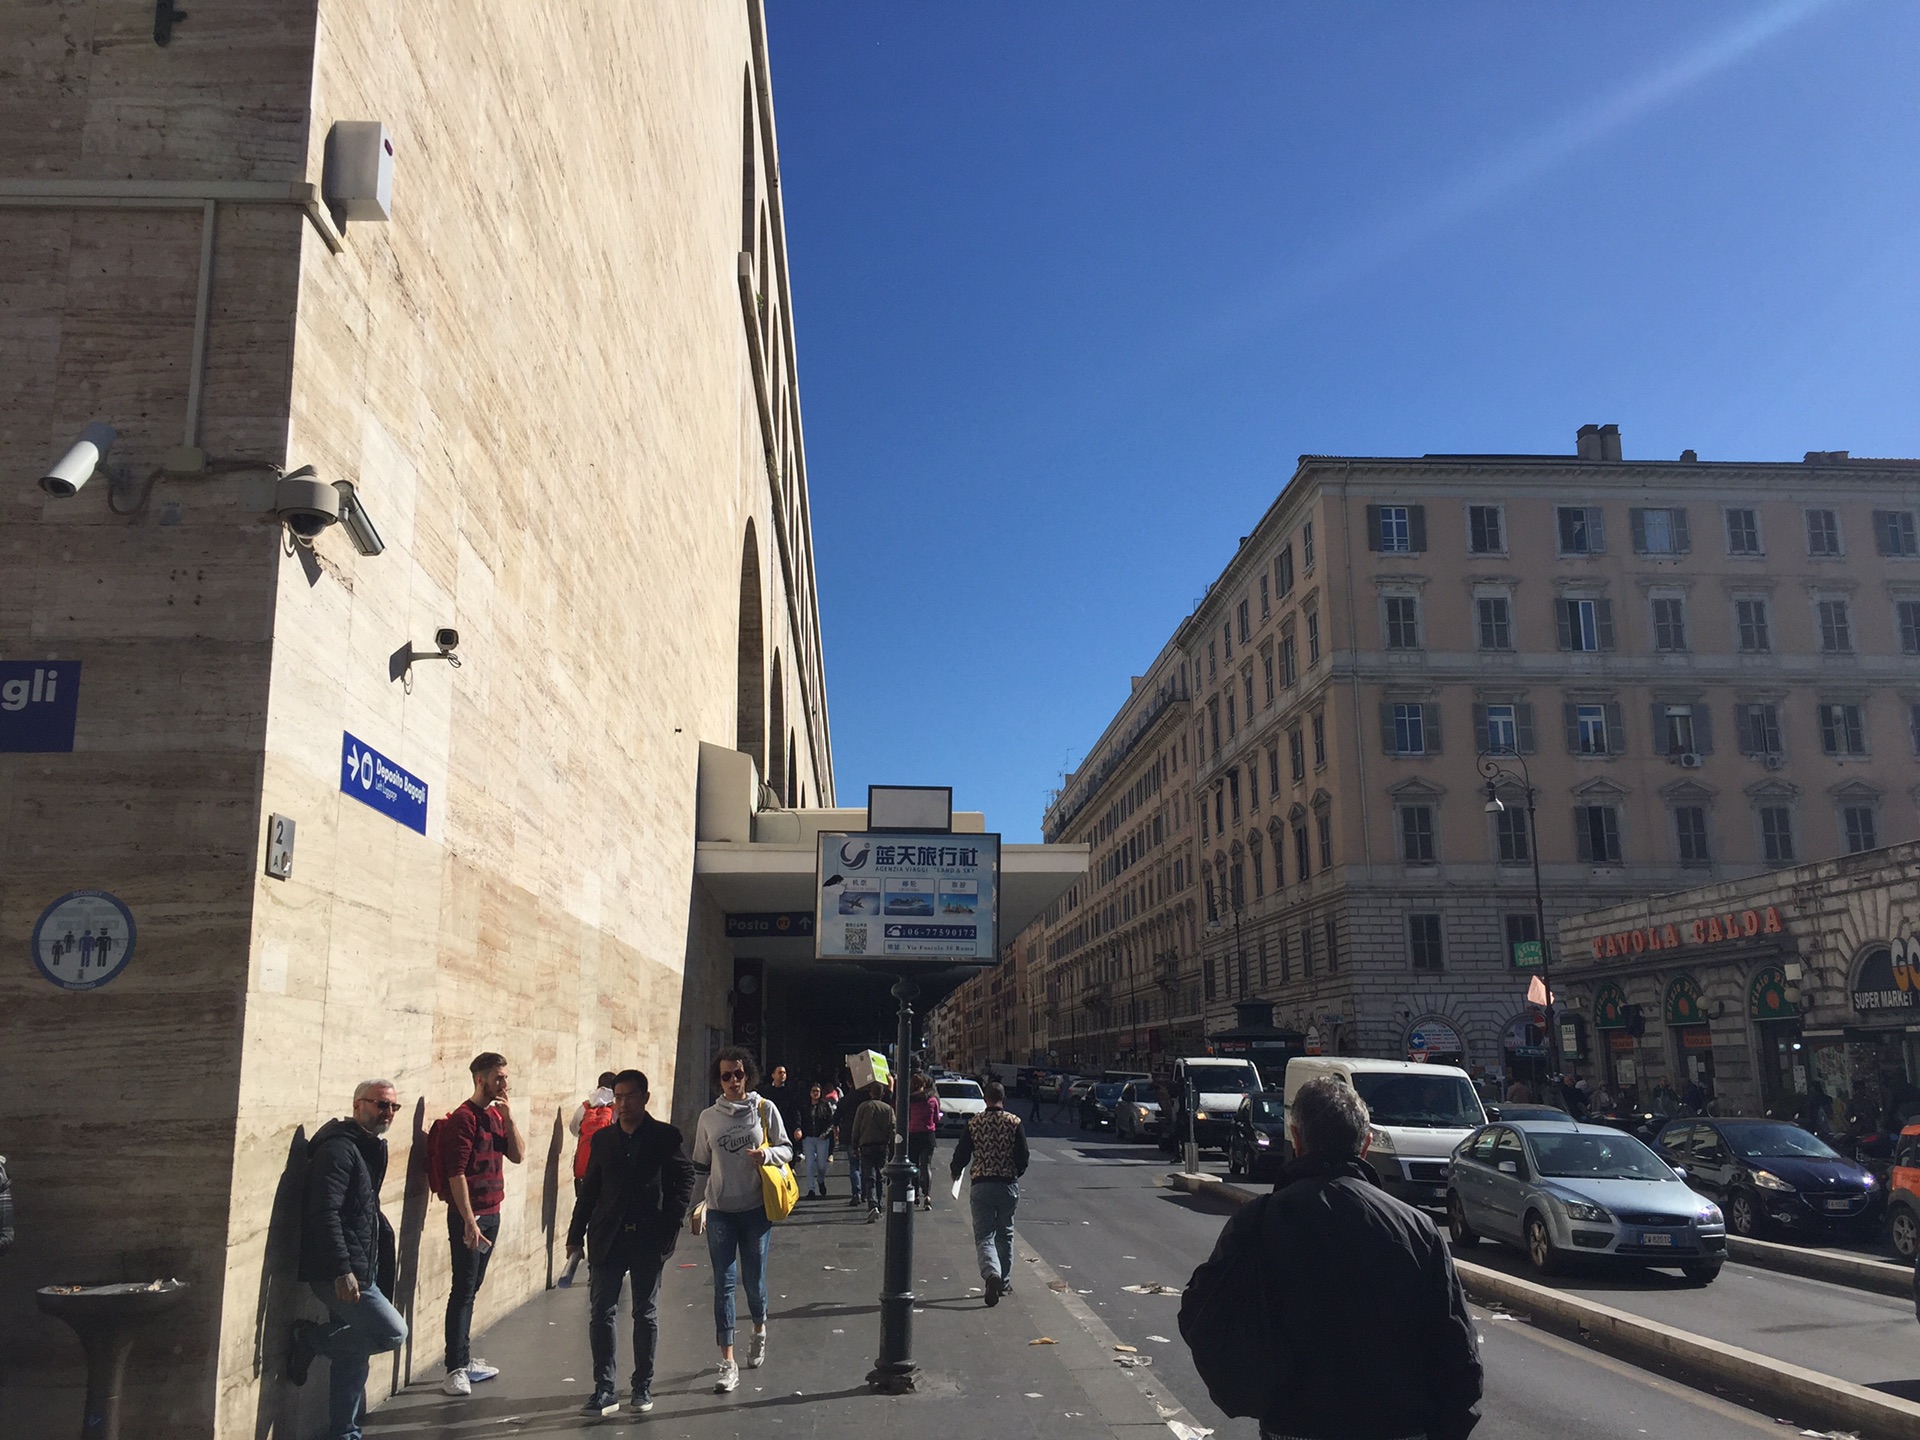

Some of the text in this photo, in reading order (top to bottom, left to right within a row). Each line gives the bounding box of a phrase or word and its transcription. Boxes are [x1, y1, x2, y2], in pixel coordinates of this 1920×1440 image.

[376, 757, 426, 805] Deposito Bagagli
[383, 781, 398, 803] Luggage
[275, 820, 284, 845] 2
[273, 855, 279, 868] A
[875, 845, 979, 867] 蓝天旅行社
[72, 889, 103, 898] SECURITY
[728, 918, 769, 931] Posta
[1592, 906, 1783, 959] TAVOLA CALDA
[1853, 989, 1913, 1009] SUPER MARKET
[1171, 1029, 1194, 1040] CHANGE
